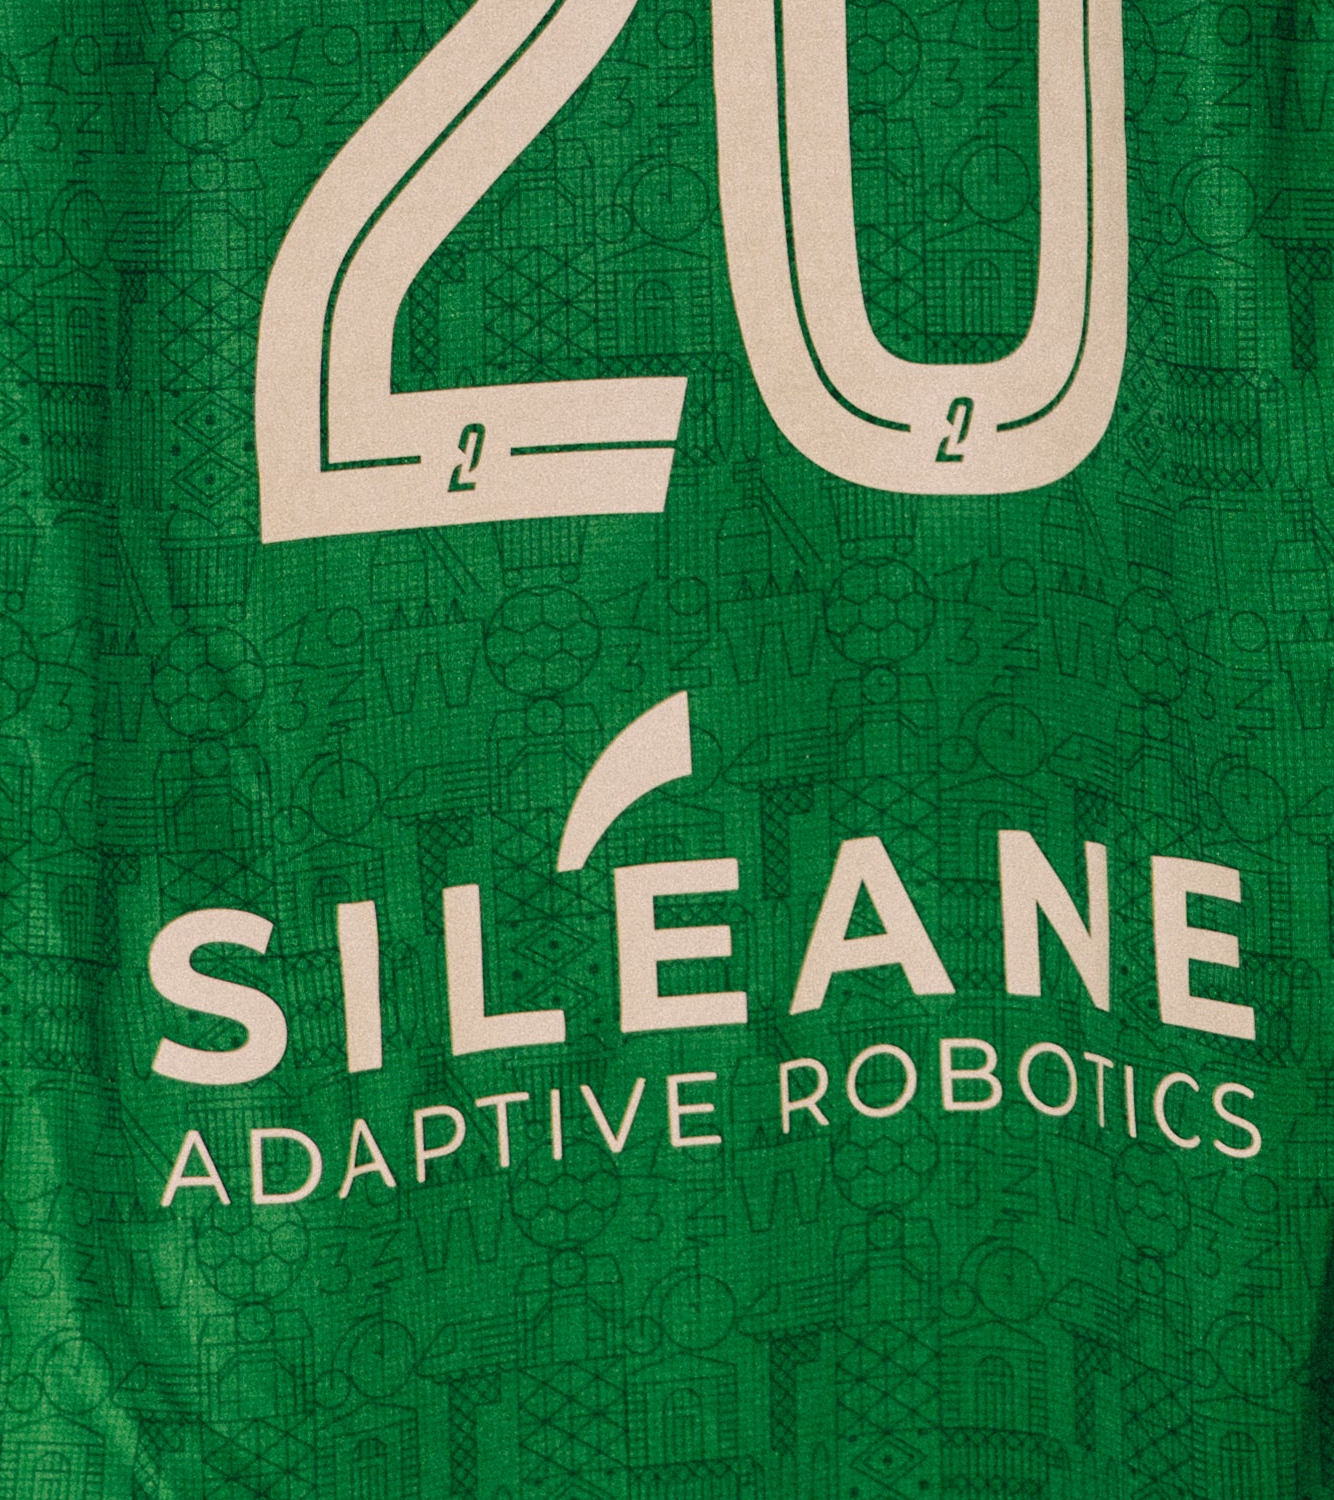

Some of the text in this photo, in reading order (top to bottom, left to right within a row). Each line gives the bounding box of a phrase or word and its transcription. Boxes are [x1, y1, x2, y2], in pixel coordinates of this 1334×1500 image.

[148, 691, 1255, 1085] SILÉANE
[152, 1038, 1261, 1206] ADAPTIVE ROBOTICS
